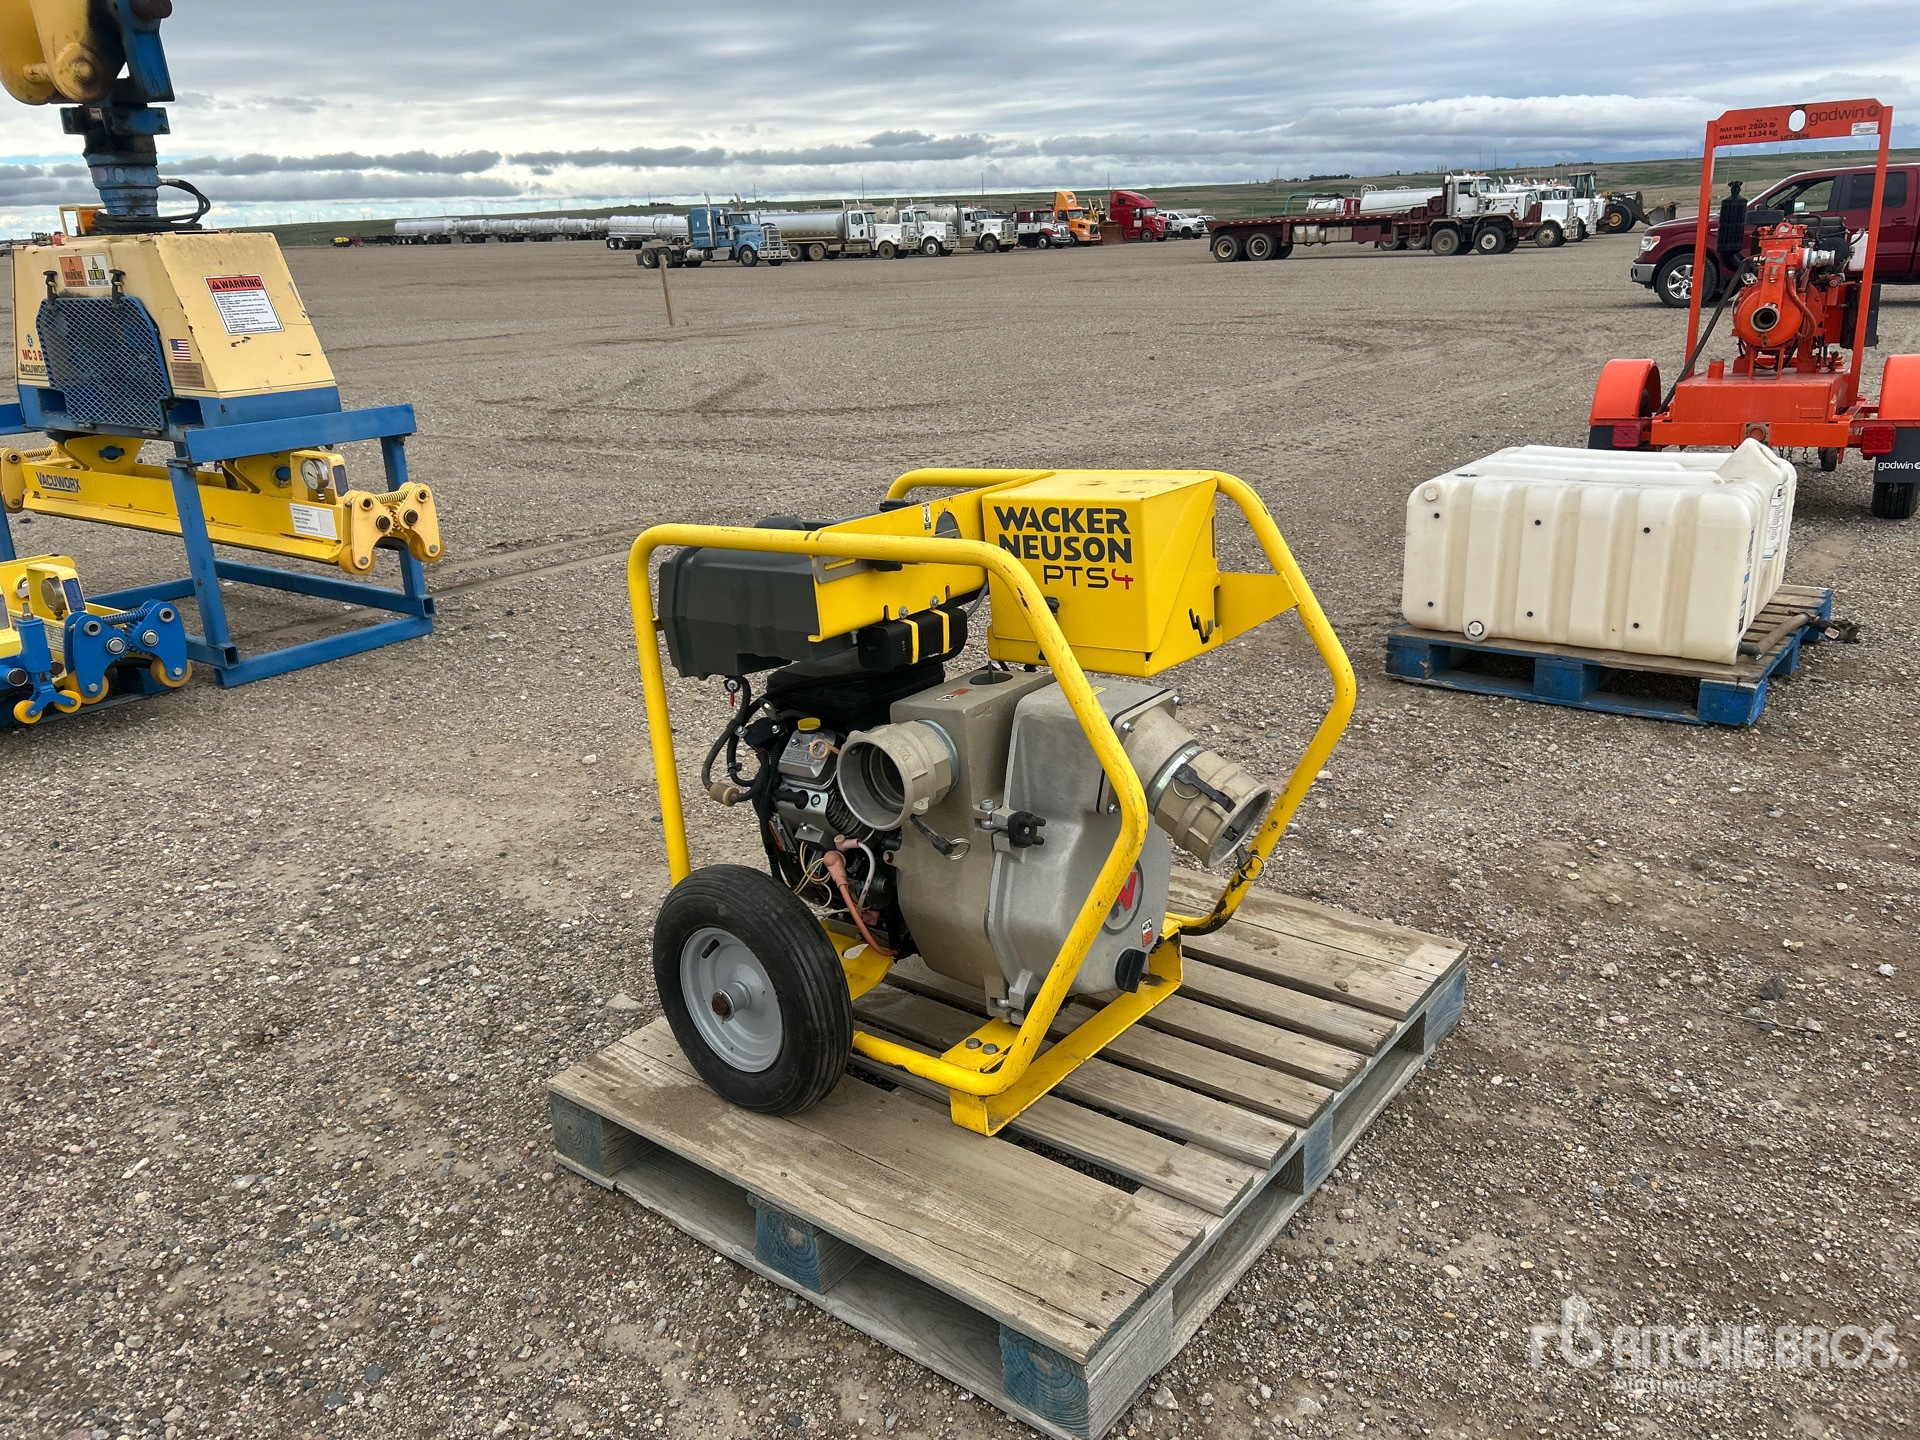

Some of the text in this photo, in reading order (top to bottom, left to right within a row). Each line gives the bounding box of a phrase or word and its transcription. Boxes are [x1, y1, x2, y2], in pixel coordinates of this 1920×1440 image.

[1809, 107, 1864, 126] godwin
[1748, 122, 1768, 130] 2500
[220, 278, 262, 289] WARNING
[22, 349, 32, 361] MC
[33, 349, 38, 361] 3
[20, 360, 47, 376] VACUWOR
[1877, 461, 1914, 471] godwin
[35, 471, 82, 492] VACUWORX
[993, 506, 1131, 534] WACKER
[998, 533, 1133, 564] NEUSON
[1043, 564, 1134, 590] PTS4
